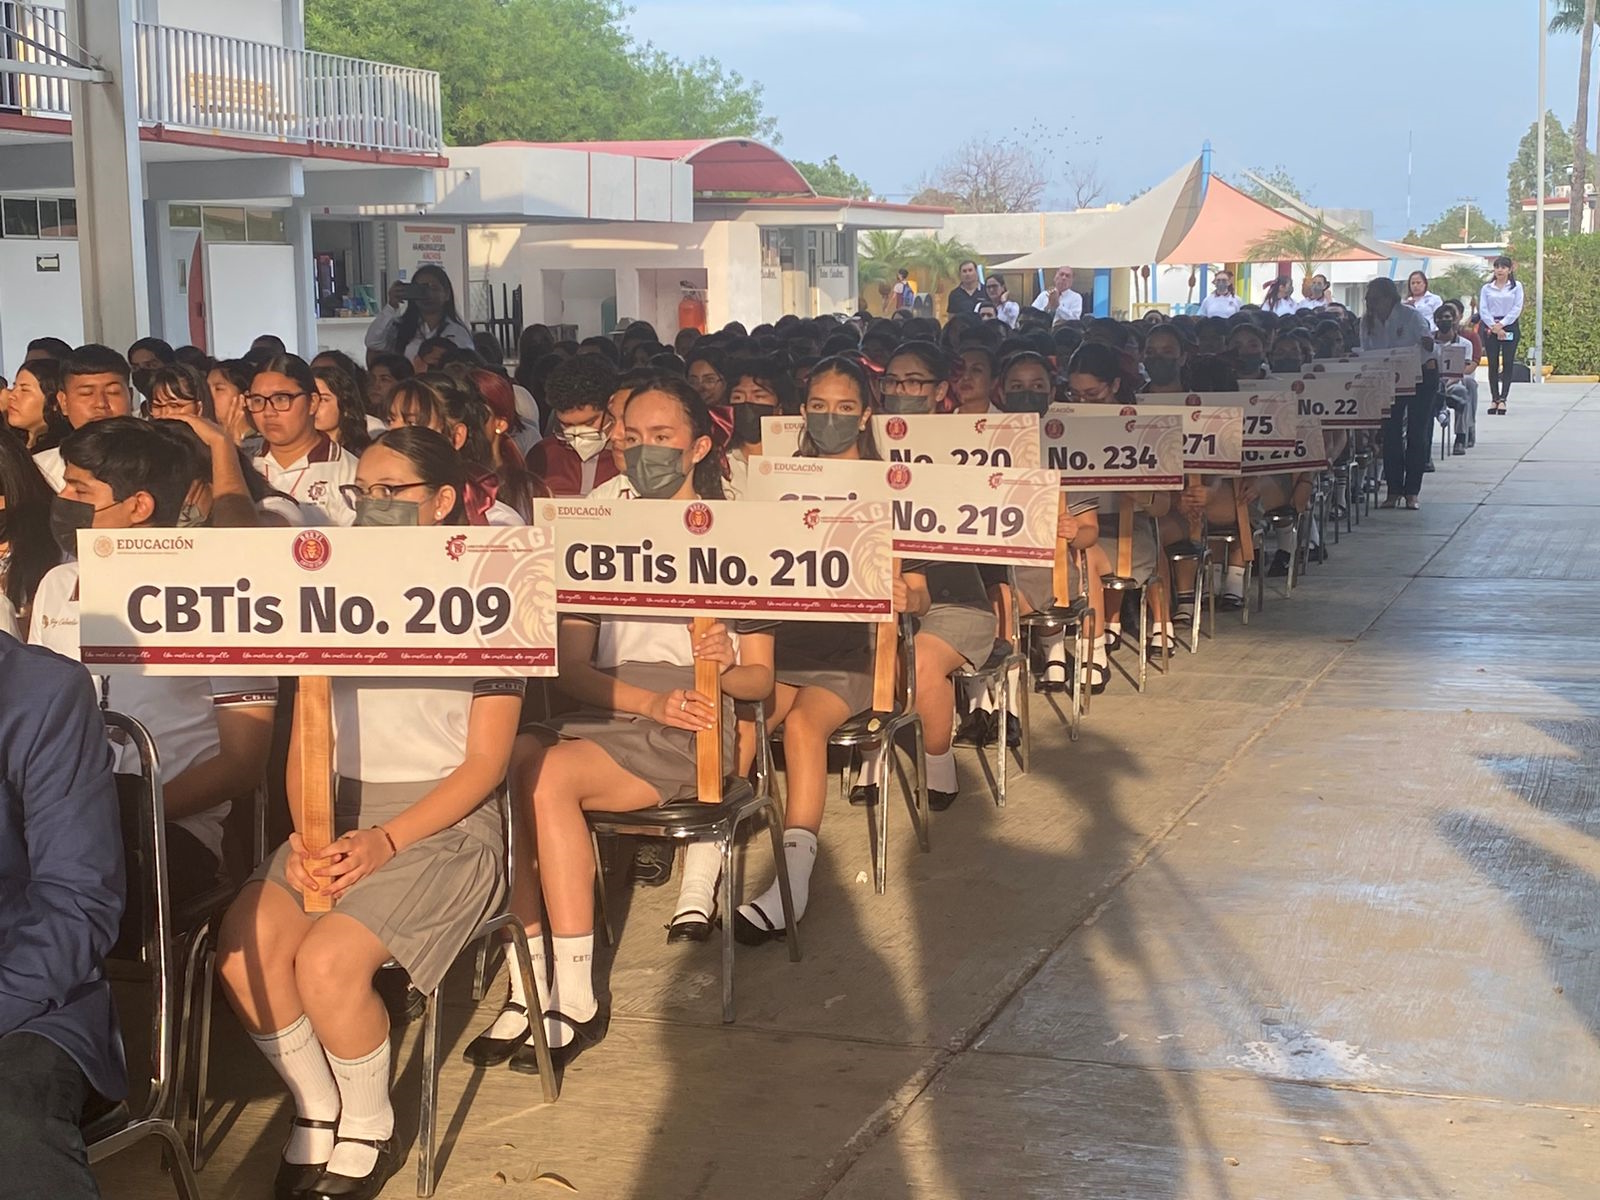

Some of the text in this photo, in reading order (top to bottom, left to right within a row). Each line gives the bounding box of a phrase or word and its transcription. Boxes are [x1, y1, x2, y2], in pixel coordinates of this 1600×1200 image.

[1297, 399, 1358, 415] No. 22
[1242, 416, 1273, 435] 75
[1048, 446, 1157, 470] No. 234
[774, 463, 823, 473] EDUCACIÓN
[558, 505, 612, 516] EDUCACIÓN
[892, 500, 1024, 538] No. 219
[117, 535, 194, 550] EDUCACIÓN
[565, 539, 849, 588] CBTis No. 210
[127, 577, 511, 636] CBTis No. 209
